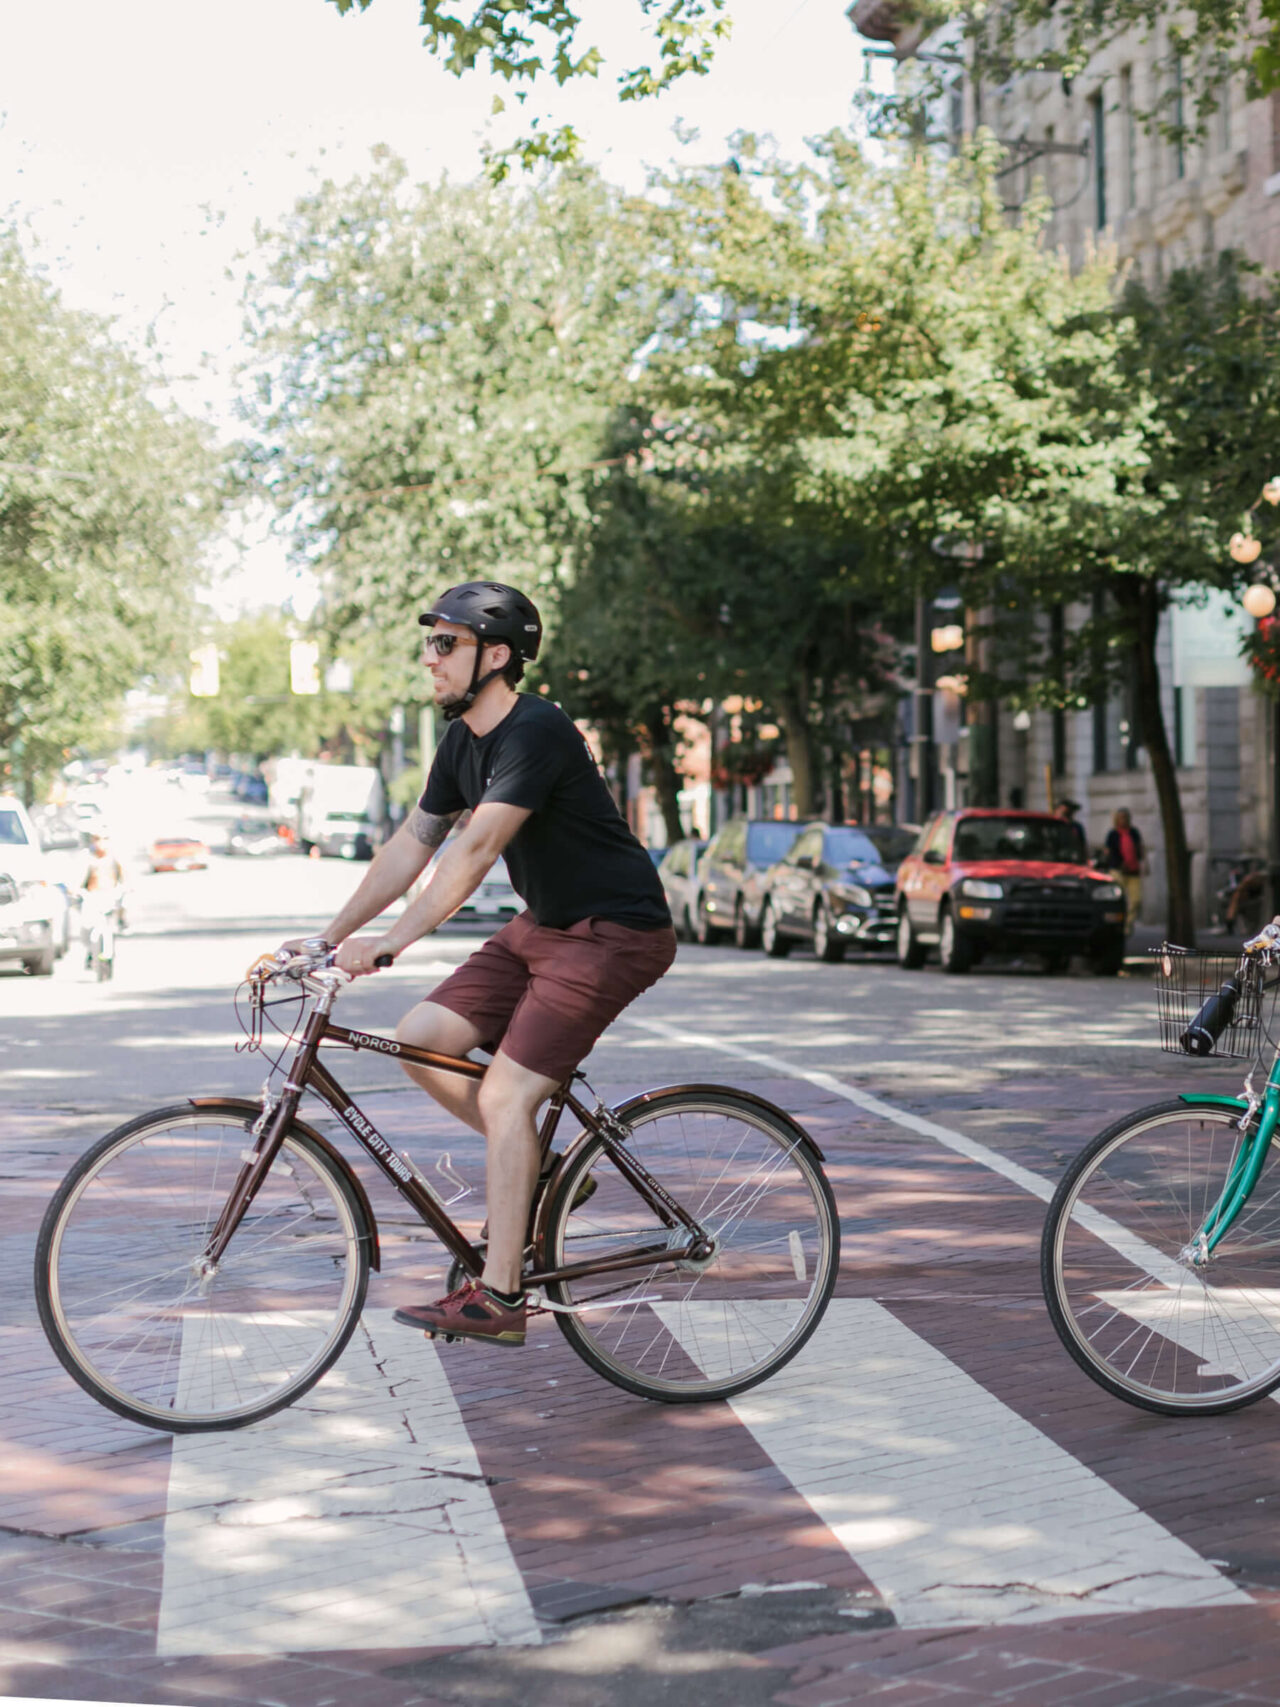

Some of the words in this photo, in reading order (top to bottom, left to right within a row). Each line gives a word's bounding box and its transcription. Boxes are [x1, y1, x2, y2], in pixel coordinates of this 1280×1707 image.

[348, 1031, 401, 1053] NORCO
[343, 1106, 373, 1137] CYCLE
[367, 1133, 390, 1155] CITY
[386, 1152, 412, 1182] TOURS
